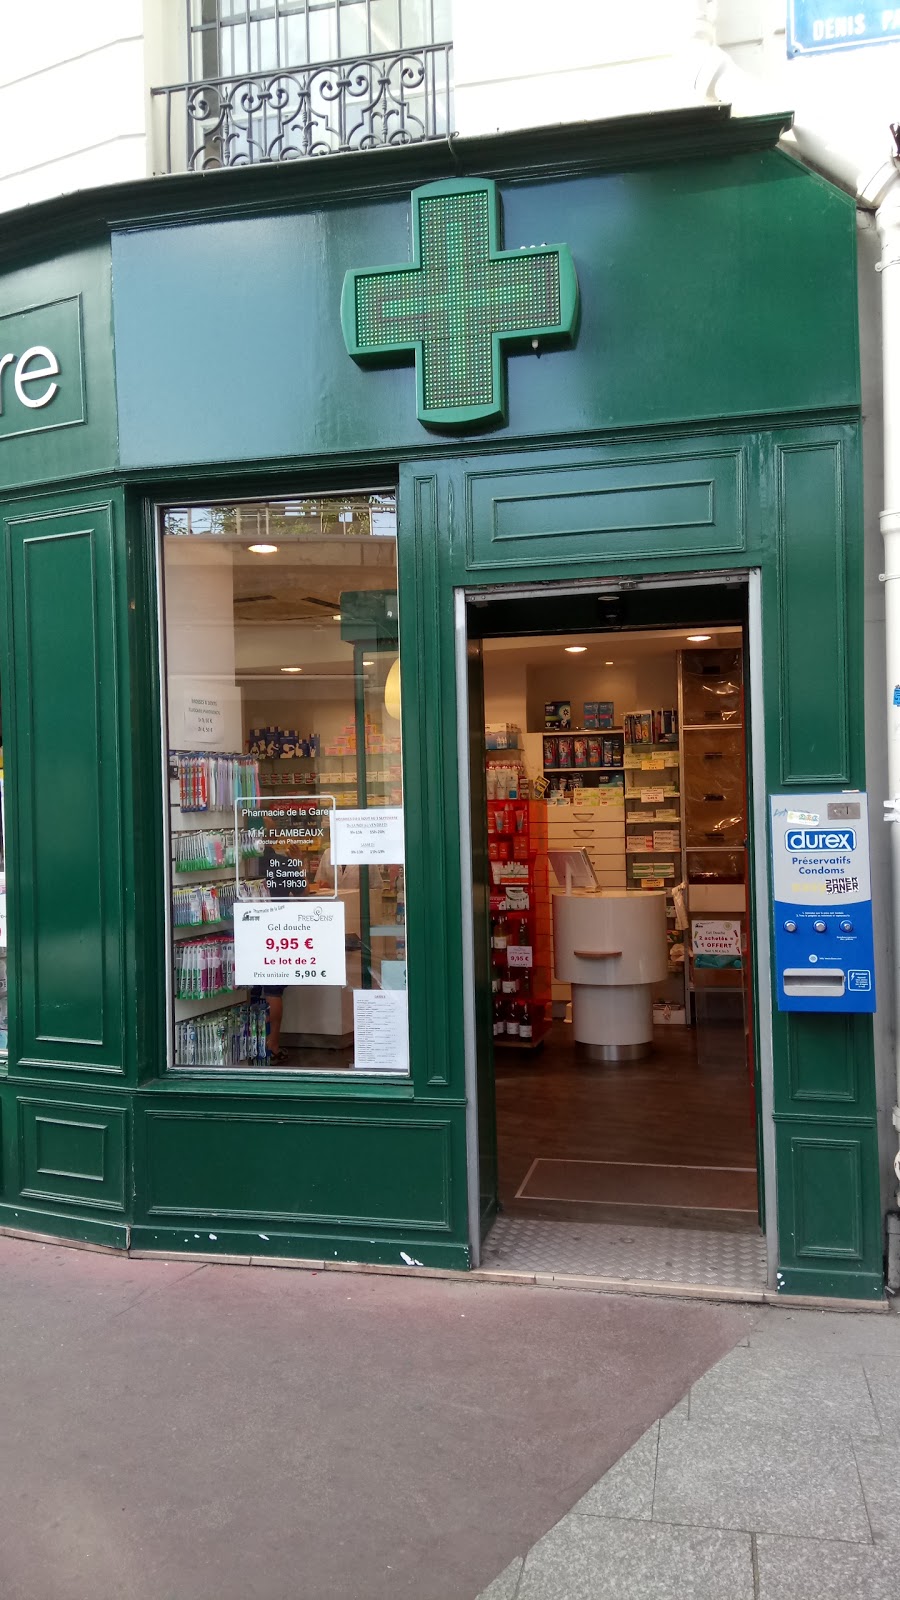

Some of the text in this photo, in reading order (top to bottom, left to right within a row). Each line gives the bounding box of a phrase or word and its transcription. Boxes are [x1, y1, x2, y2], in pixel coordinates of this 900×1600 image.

[812, 13, 866, 41] DENIS
[241, 809, 285, 817] Pharmacie
[286, 808, 297, 816] de
[308, 807, 330, 815] Gare
[248, 829, 324, 838] M.H. FLAMBEAUX
[790, 831, 853, 851] durex
[269, 859, 280, 867] 9h
[287, 858, 303, 867] 20h
[792, 856, 851, 864] Préservatifs
[266, 880, 277, 888] 9h
[826, 883, 859, 892] SANER
[283, 923, 311, 931] douche
[265, 938, 314, 952] 9,95 €
[295, 957, 307, 965] de
[310, 957, 317, 965] 2
[295, 970, 317, 979] 5,90
[320, 970, 327, 978] €
